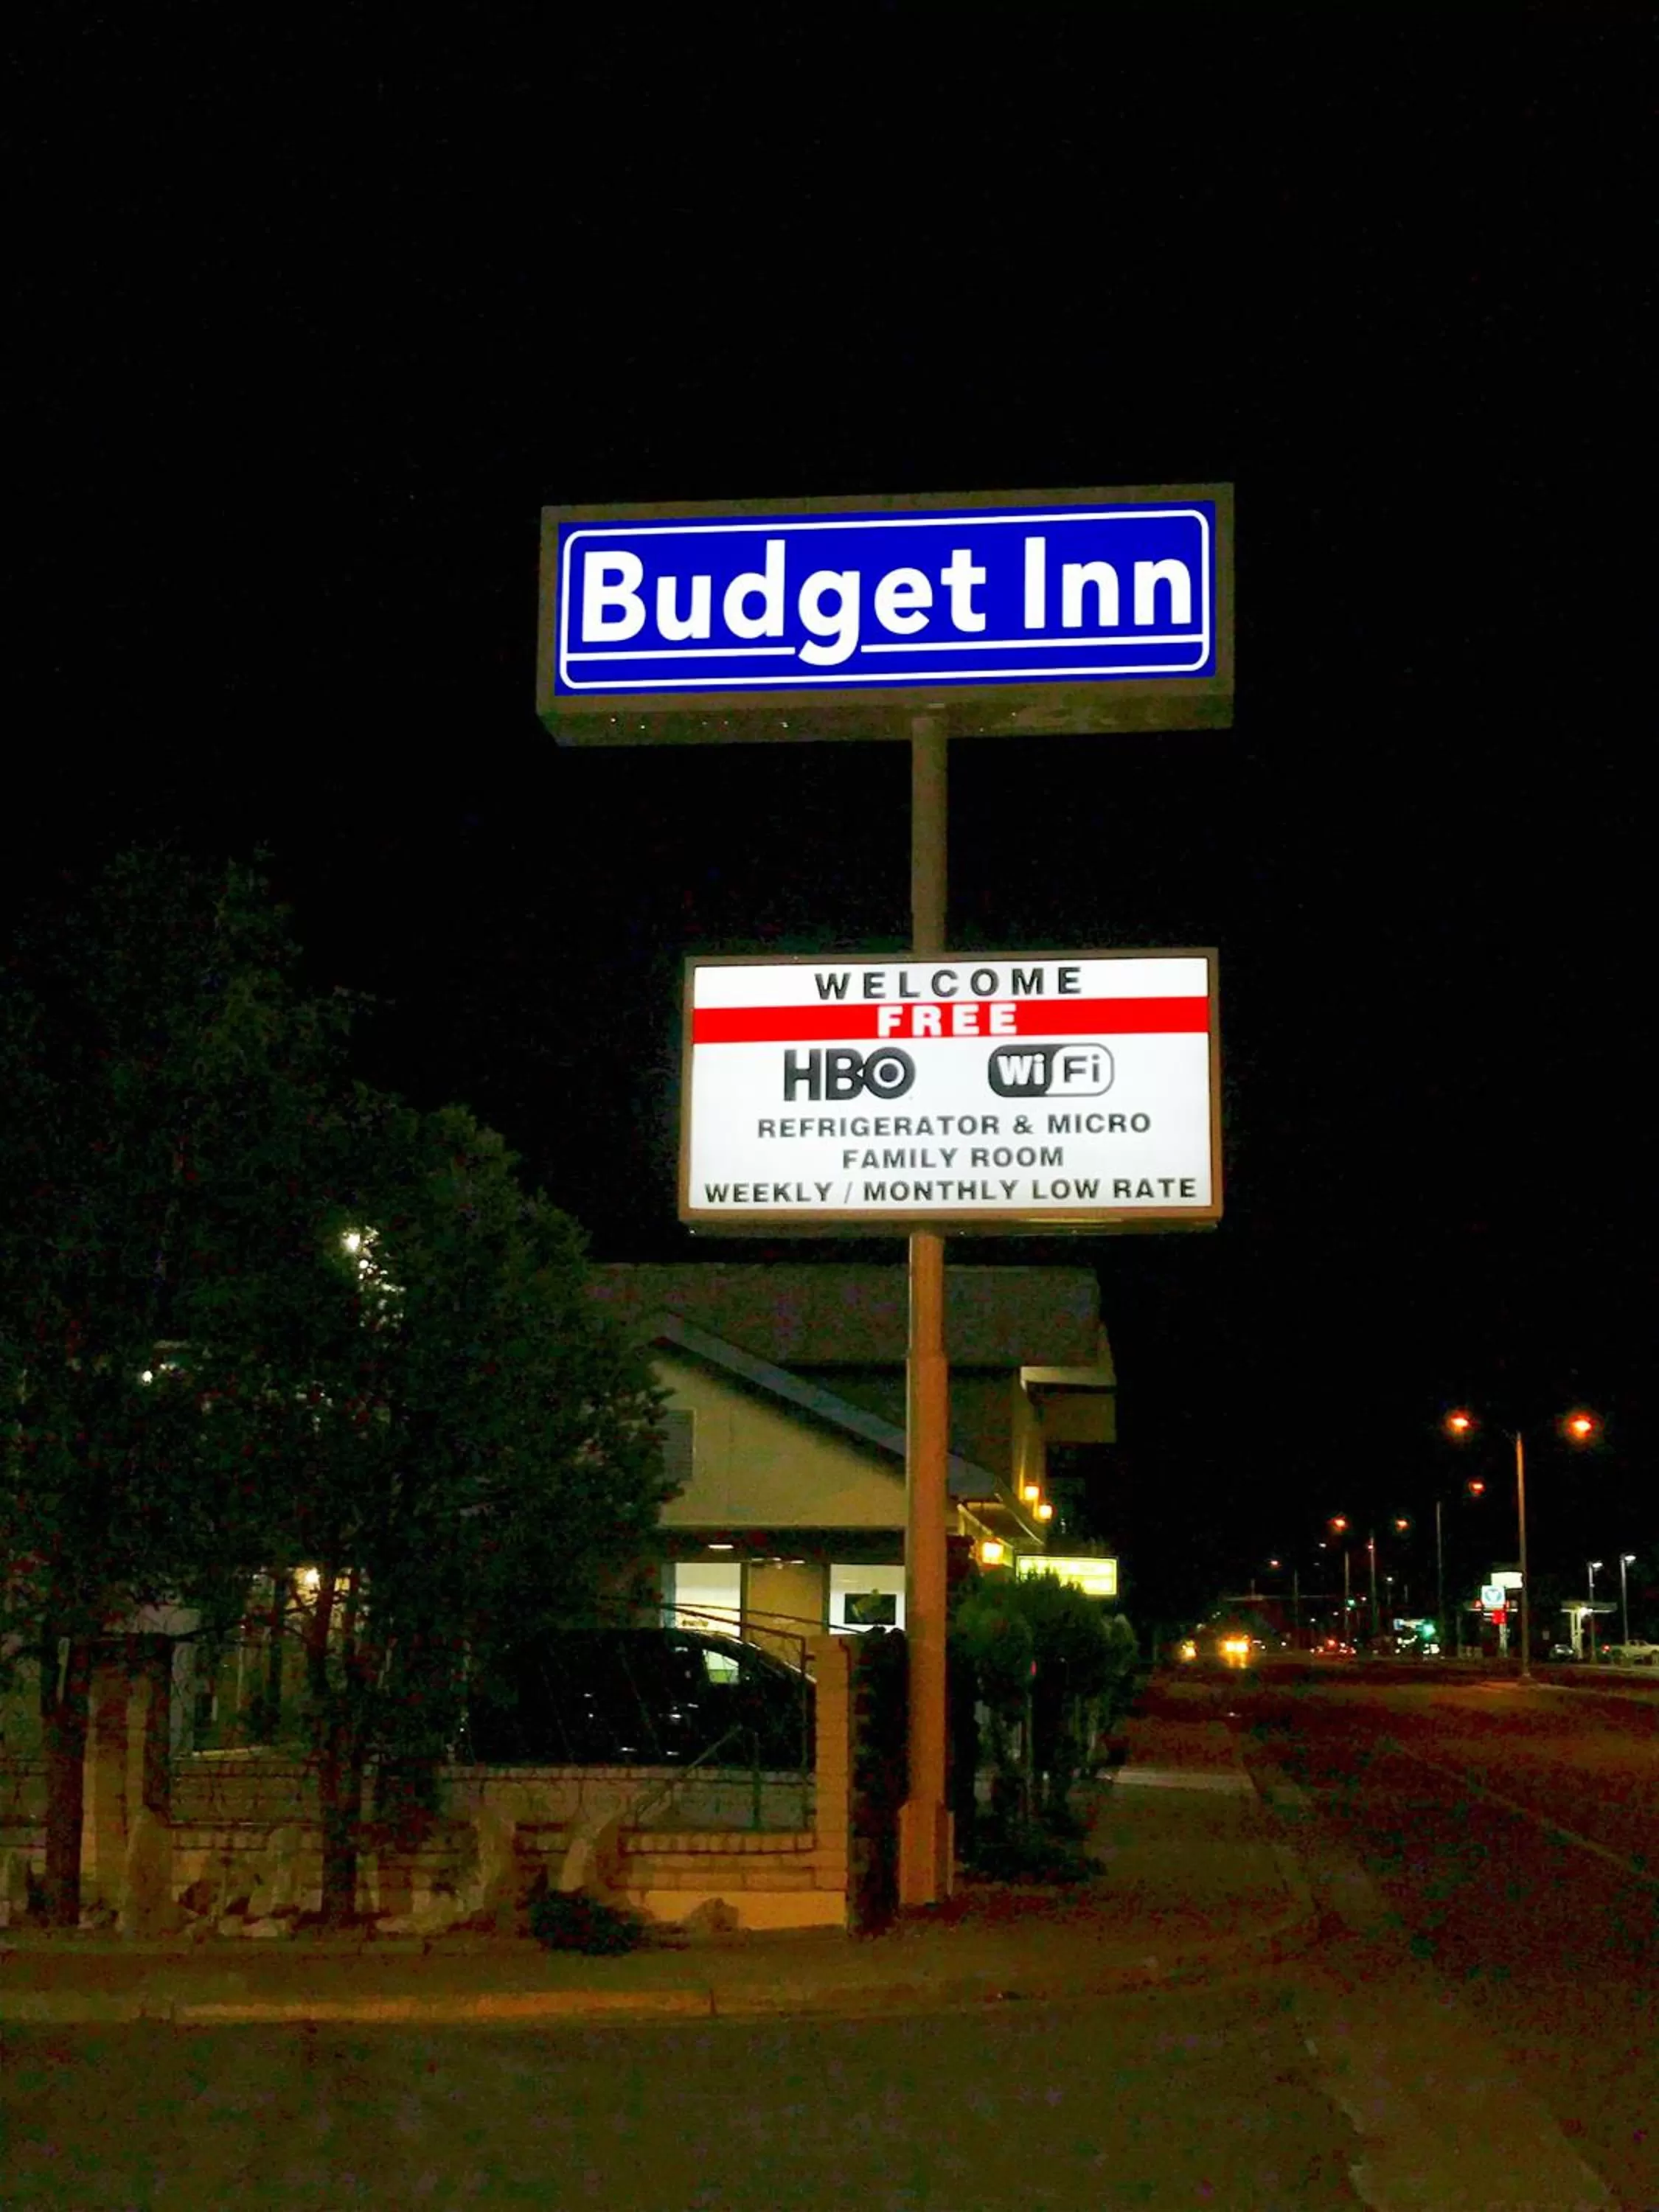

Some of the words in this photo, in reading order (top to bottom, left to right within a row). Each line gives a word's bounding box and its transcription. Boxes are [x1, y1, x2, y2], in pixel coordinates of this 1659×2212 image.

[582, 539, 987, 666] Budget
[1024, 536, 1192, 629] Inn
[815, 967, 1082, 1001] WELCOME
[877, 1002, 1018, 1037] FREE
[783, 1046, 916, 1102] HBO
[758, 1115, 999, 1138] REFRIGERATOR
[1012, 1115, 1034, 1135] &
[1048, 1113, 1151, 1134] MICRO
[843, 1148, 957, 1169] FAMILY
[971, 1147, 1063, 1167] ROOM
[705, 1182, 832, 1203] WEEKLY
[863, 1180, 1018, 1202] MONTHLY
[1032, 1179, 1099, 1200] LOW
[1113, 1178, 1197, 1200] RATE
